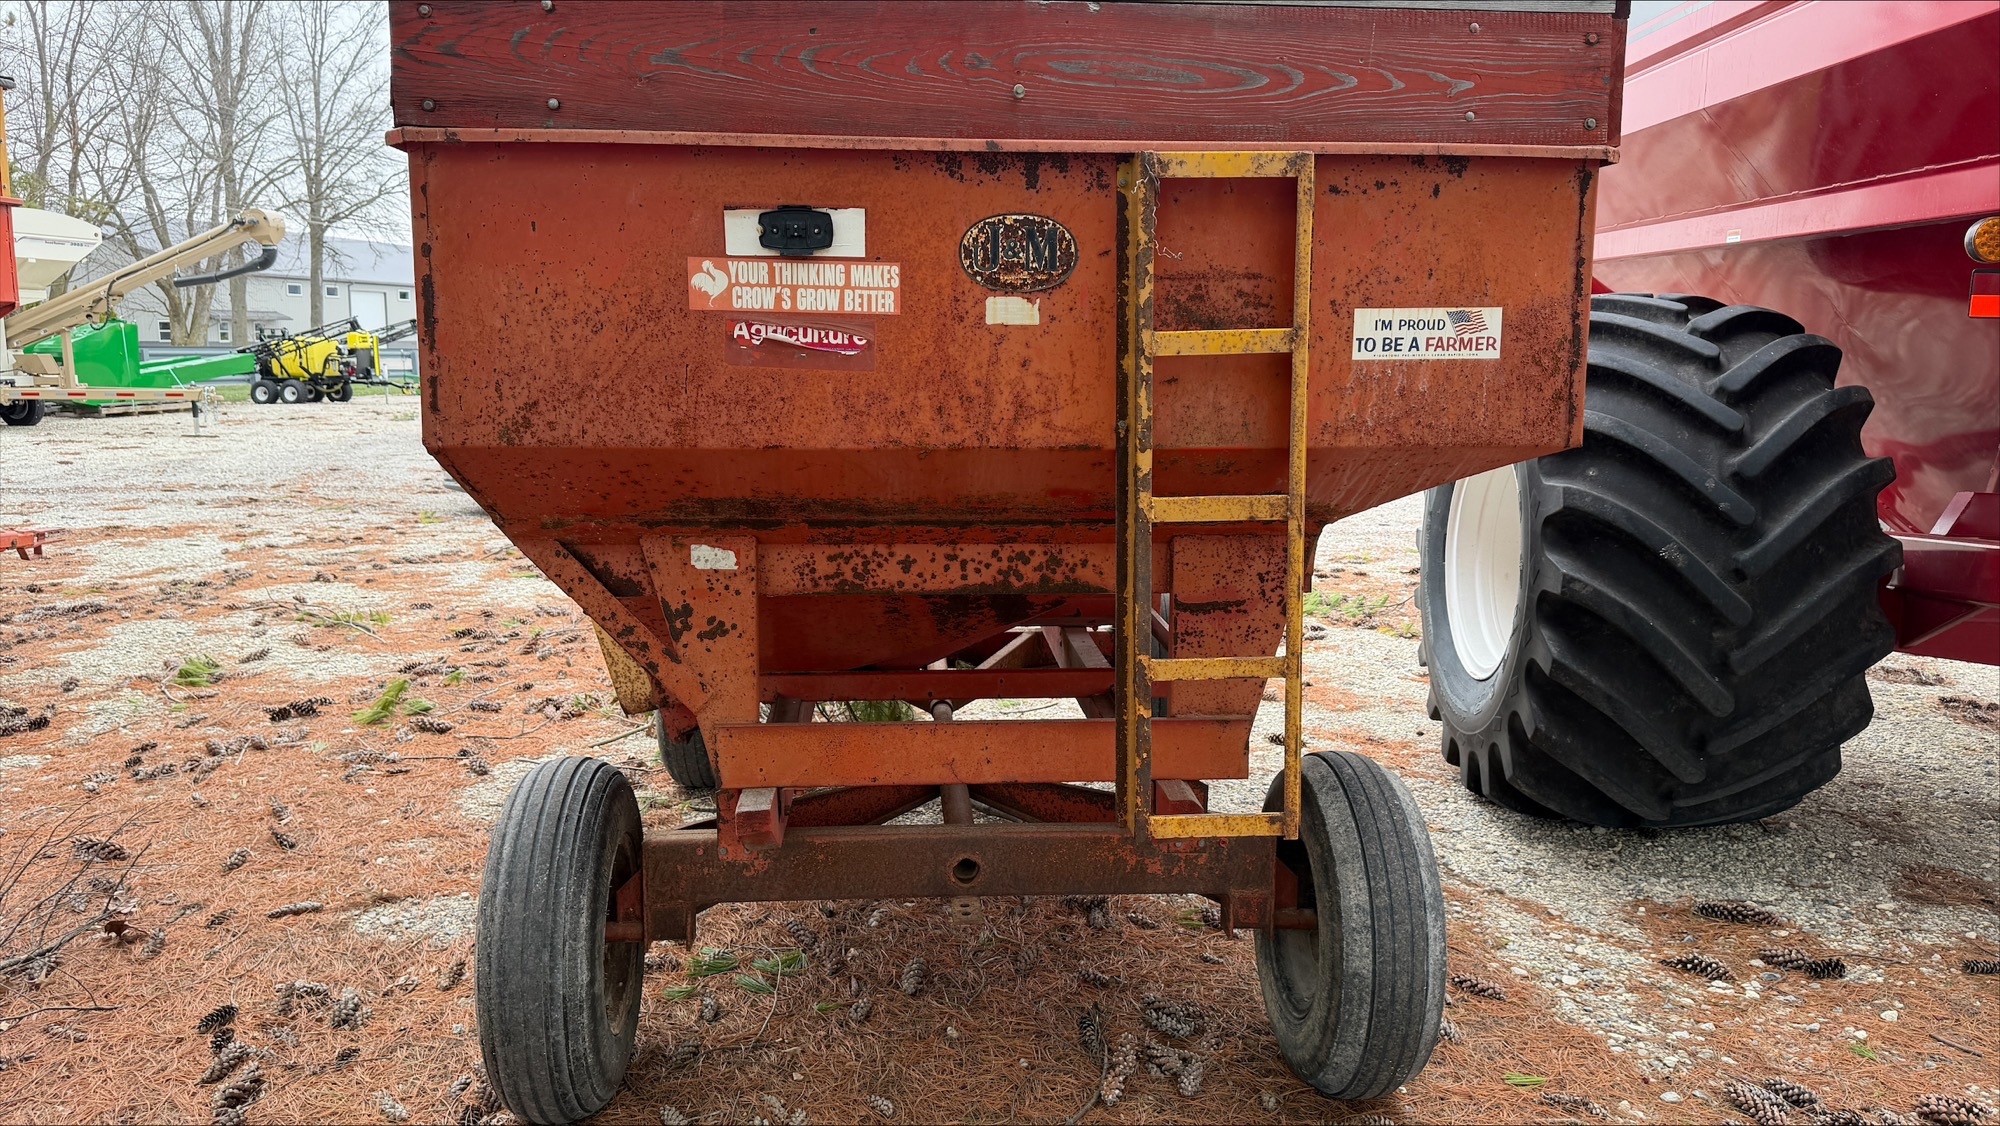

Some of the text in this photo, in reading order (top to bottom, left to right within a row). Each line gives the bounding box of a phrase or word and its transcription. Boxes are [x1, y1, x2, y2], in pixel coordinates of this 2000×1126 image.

[972, 225, 1061, 273] J&M
[727, 260, 899, 288] YOUR THINKING MAKES
[732, 285, 894, 313] CROW'S GROW BETTER
[1374, 318, 1446, 331] I'M PROUD
[1355, 336, 1497, 352] TO BE A FARMER
